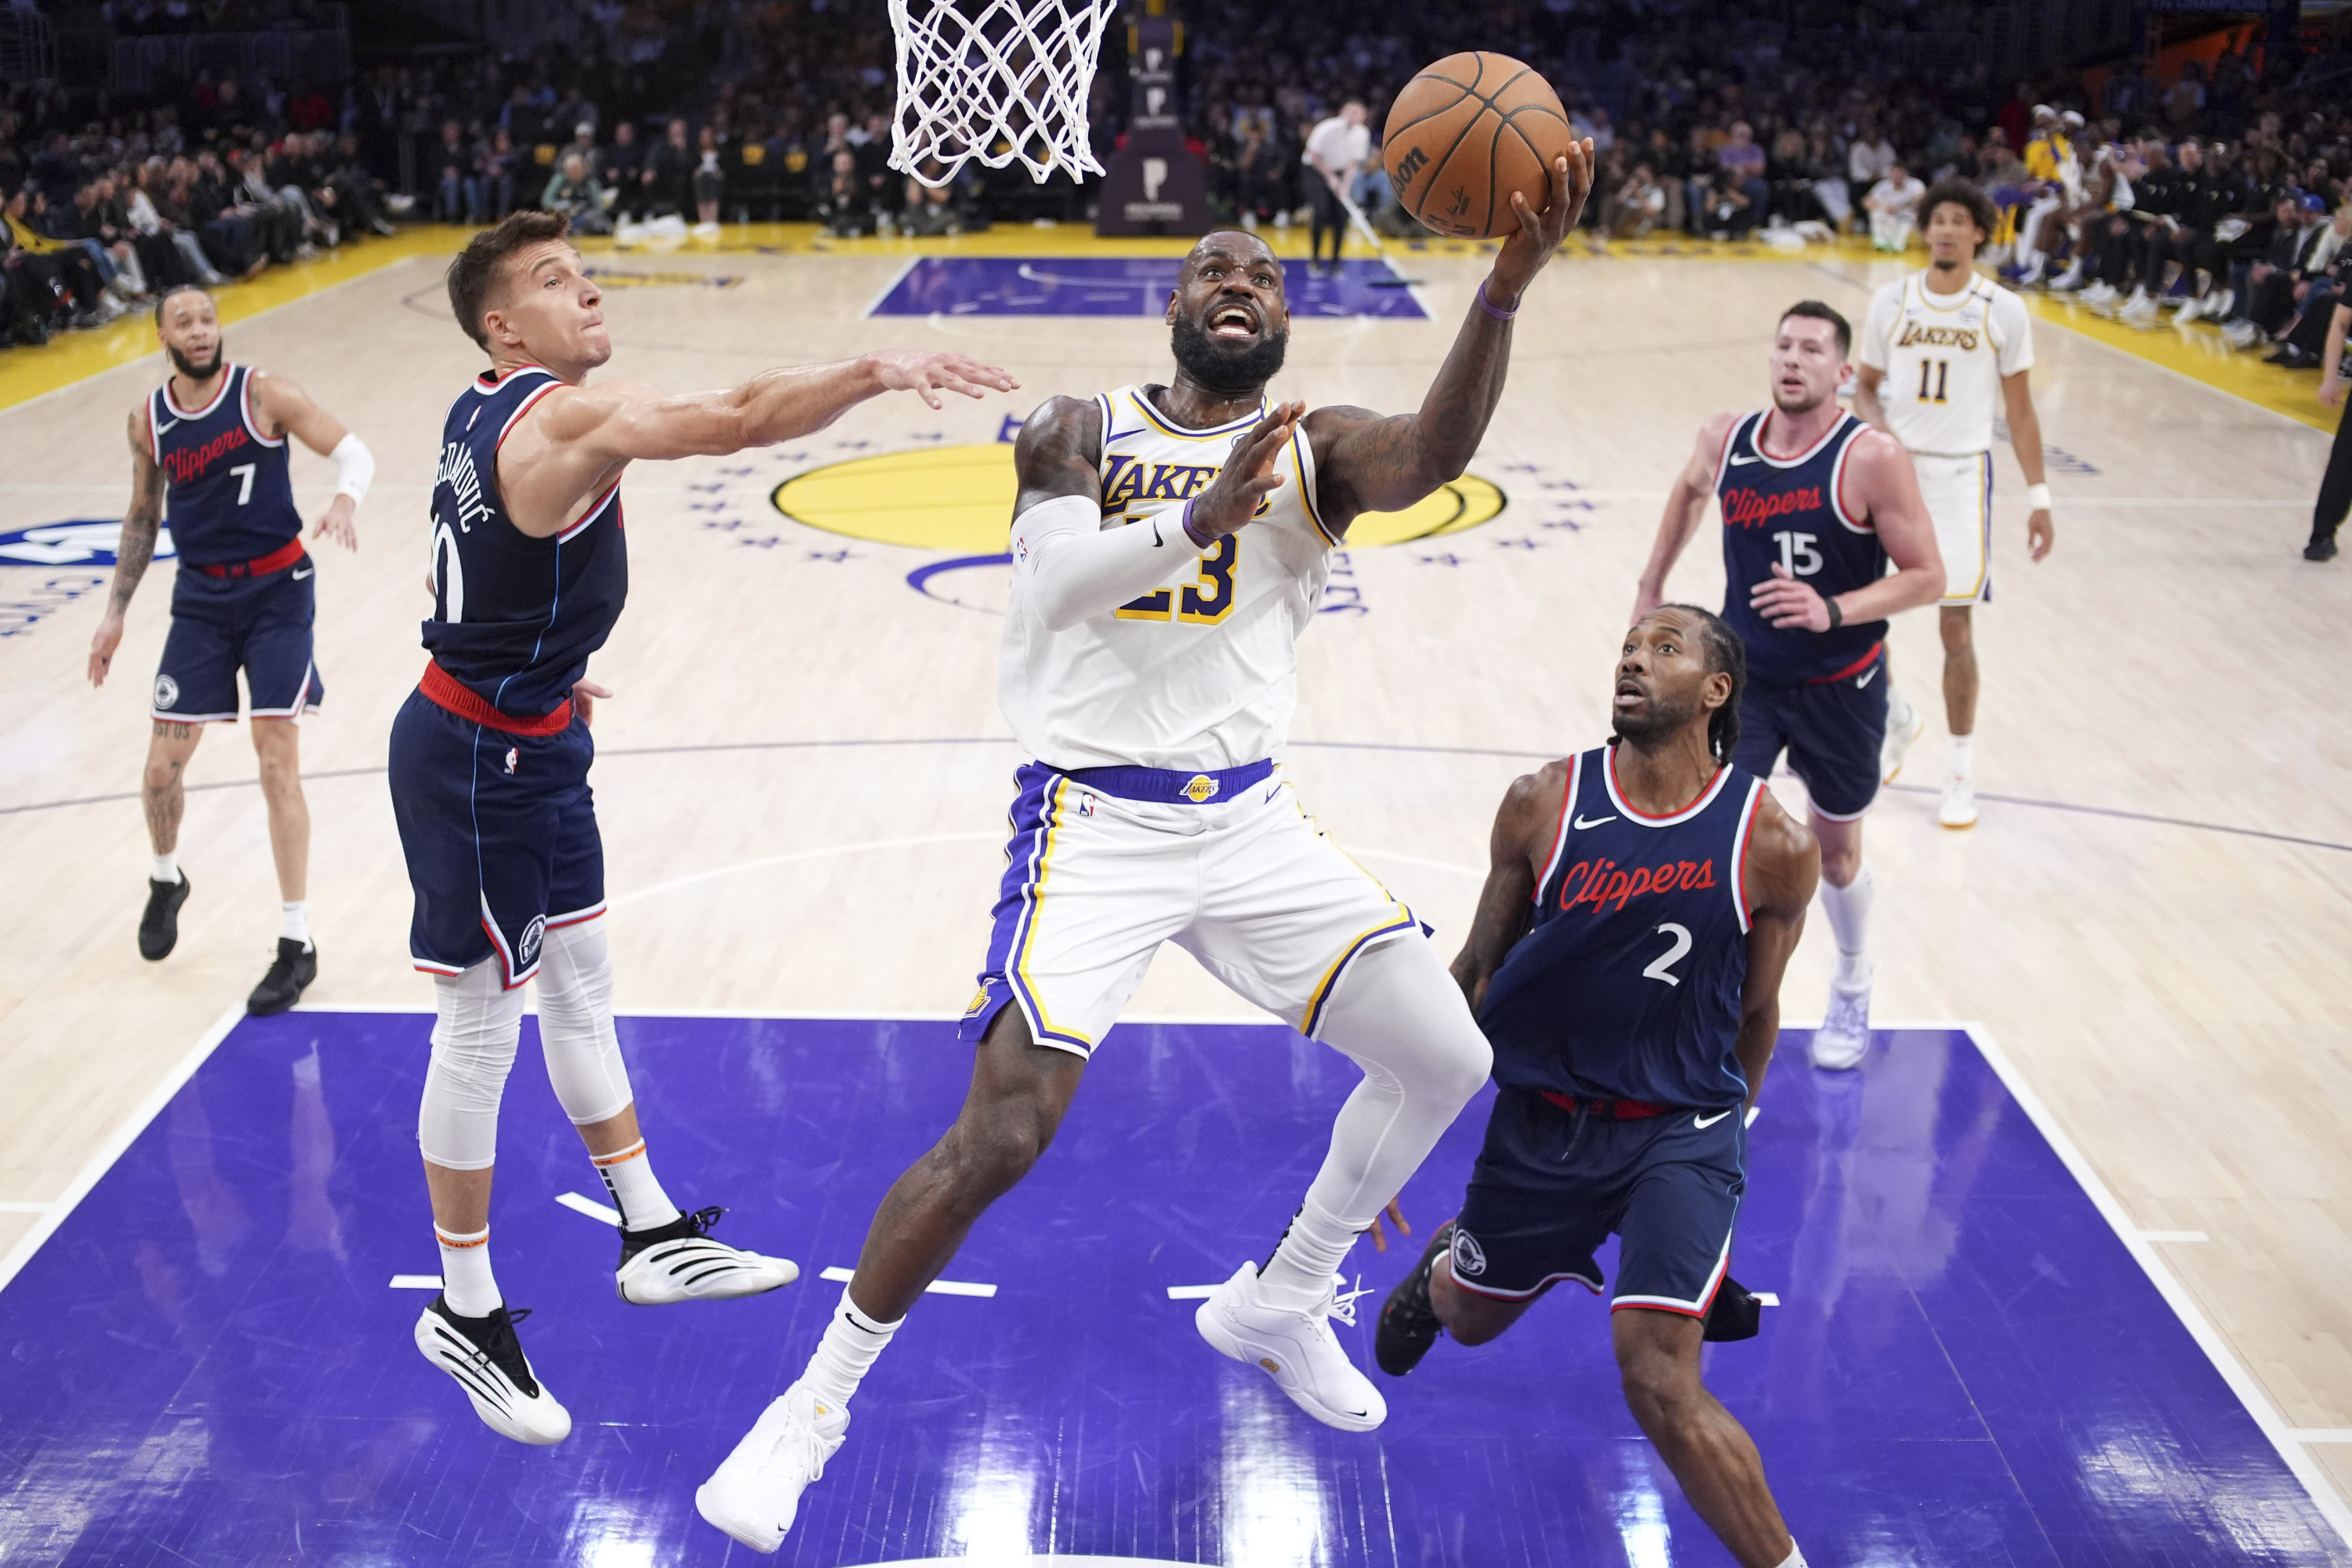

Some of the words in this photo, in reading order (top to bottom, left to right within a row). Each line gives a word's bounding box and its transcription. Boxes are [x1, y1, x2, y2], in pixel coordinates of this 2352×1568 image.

[1897, 320, 1979, 350] LAKERS
[1918, 358, 1948, 404] 11
[164, 426, 249, 484] Clippers
[230, 463, 256, 506] 7
[436, 441, 495, 534] GDANOVIĆ
[1101, 454, 1272, 519] LAKE
[1723, 486, 1823, 530] Clippers
[1773, 530, 1824, 579] 15
[1182, 782, 1217, 795] LAKERS
[1560, 858, 1717, 913] Clippers
[1642, 922, 1693, 987] 2
